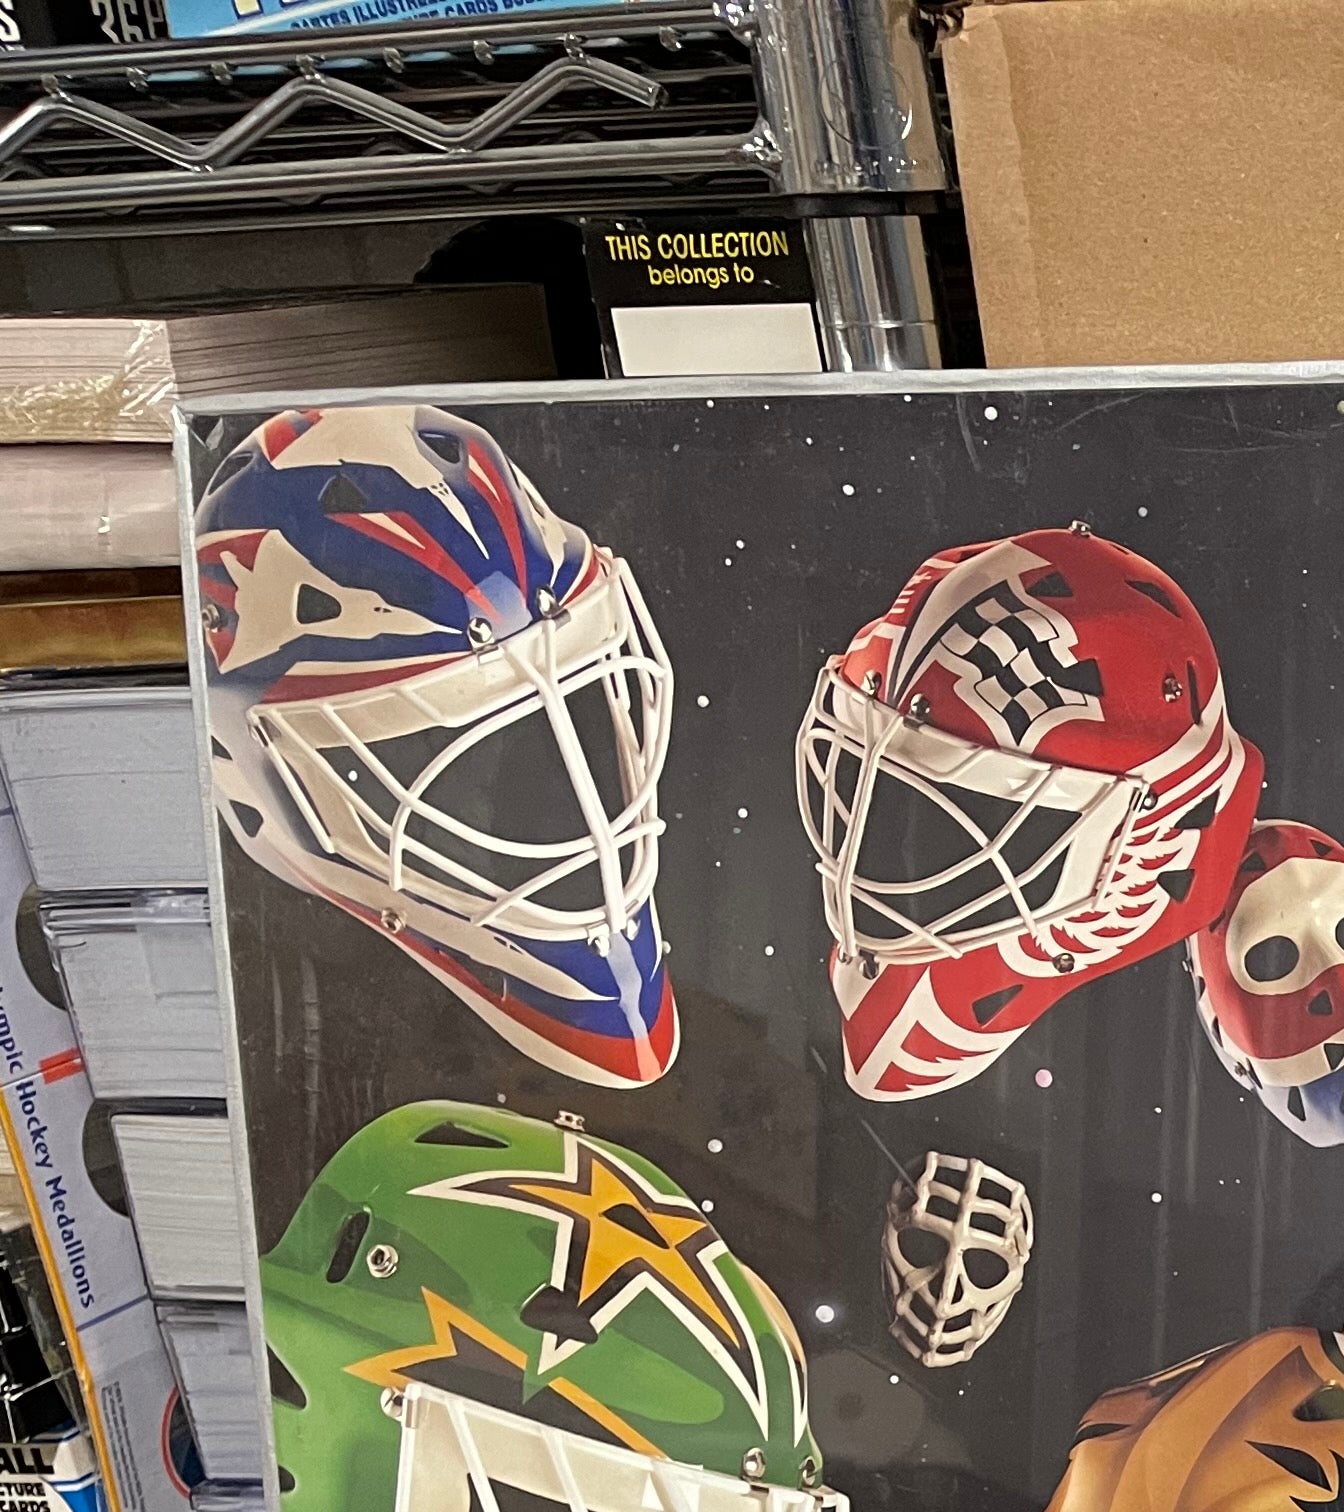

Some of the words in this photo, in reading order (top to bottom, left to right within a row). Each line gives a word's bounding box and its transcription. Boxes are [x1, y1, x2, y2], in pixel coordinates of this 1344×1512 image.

[604, 234, 652, 261] THIS
[657, 230, 790, 260] COLLECTION
[647, 263, 730, 289] belongs
[732, 262, 755, 284] to
[15, 1080, 53, 1169] Hockey
[45, 1175, 96, 1309] Medallions
